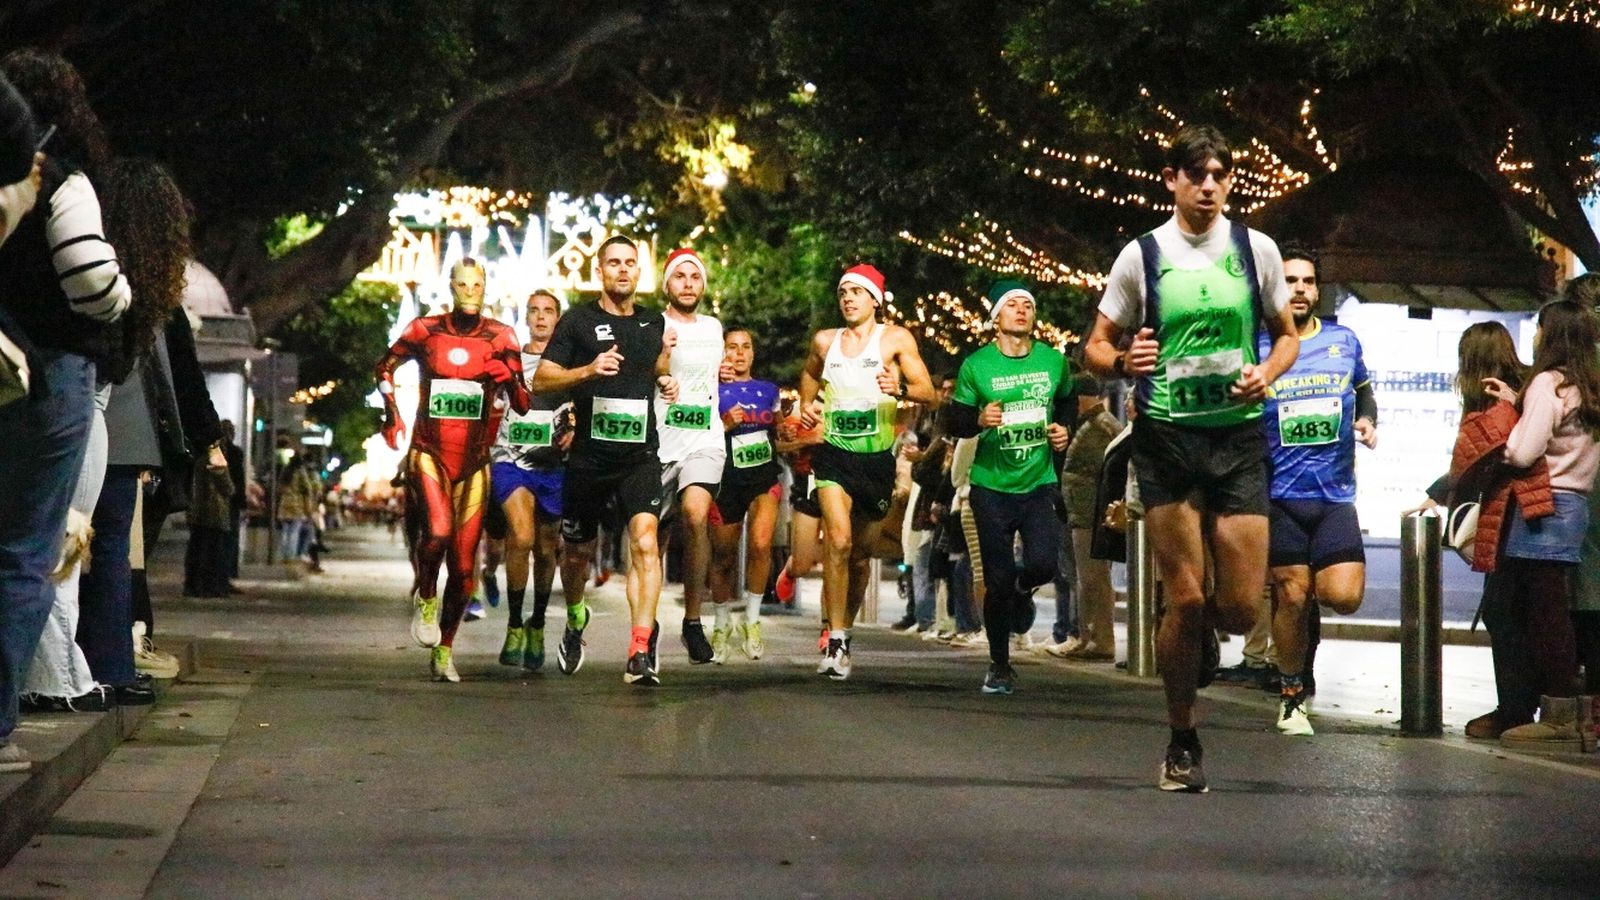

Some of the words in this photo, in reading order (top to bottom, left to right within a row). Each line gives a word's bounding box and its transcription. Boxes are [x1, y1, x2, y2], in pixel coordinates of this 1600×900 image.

[1275, 374, 1331, 391] BREAKING
[1333, 373, 1341, 384] 3
[434, 398, 478, 414] 1106
[673, 410, 705, 426] 948
[835, 416, 868, 431] 955
[512, 427, 543, 441] 979
[596, 419, 643, 437] 1579
[1003, 427, 1044, 444] 1788
[1291, 420, 1332, 439] 483
[736, 446, 770, 463] 1962
